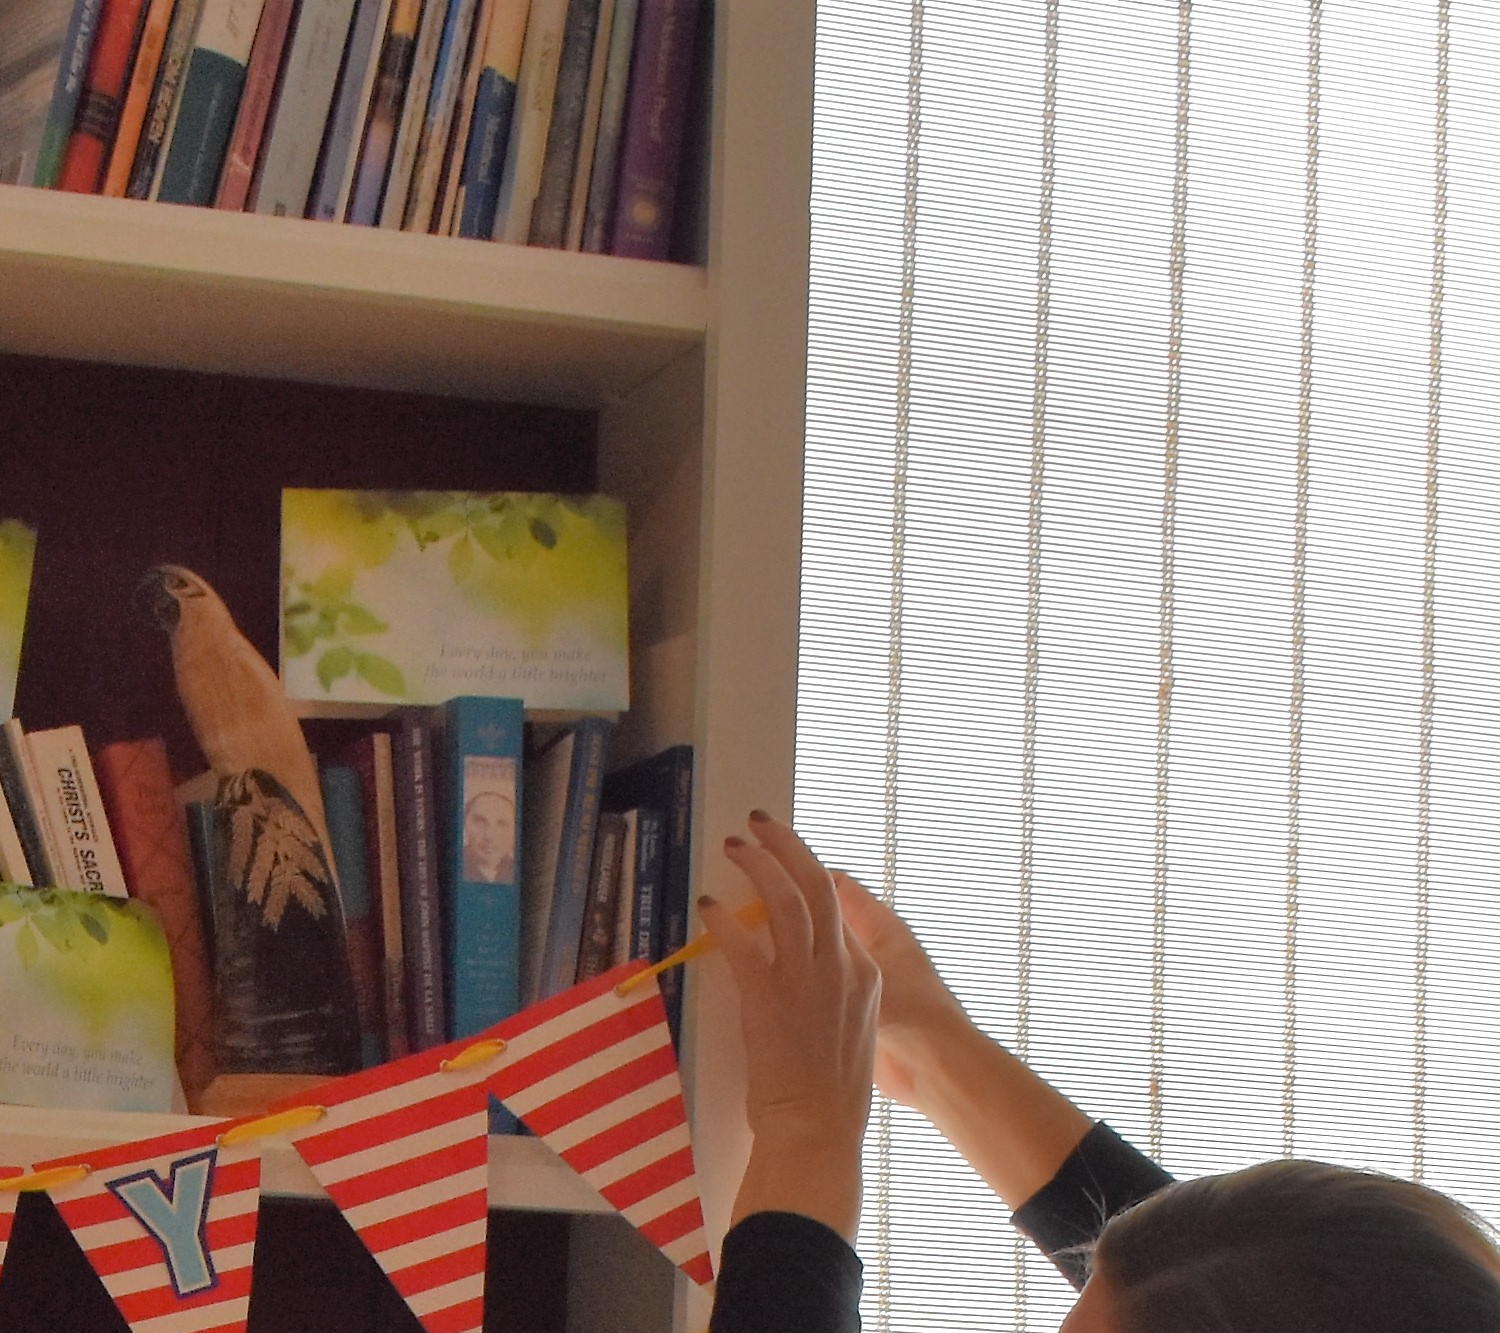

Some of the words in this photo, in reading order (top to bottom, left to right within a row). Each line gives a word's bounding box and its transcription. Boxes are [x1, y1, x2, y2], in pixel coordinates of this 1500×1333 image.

[58, 767, 88, 841] CHRIST'S
[81, 848, 103, 892] SACR
[639, 885, 652, 924] TRUE
[637, 930, 650, 959] DEV
